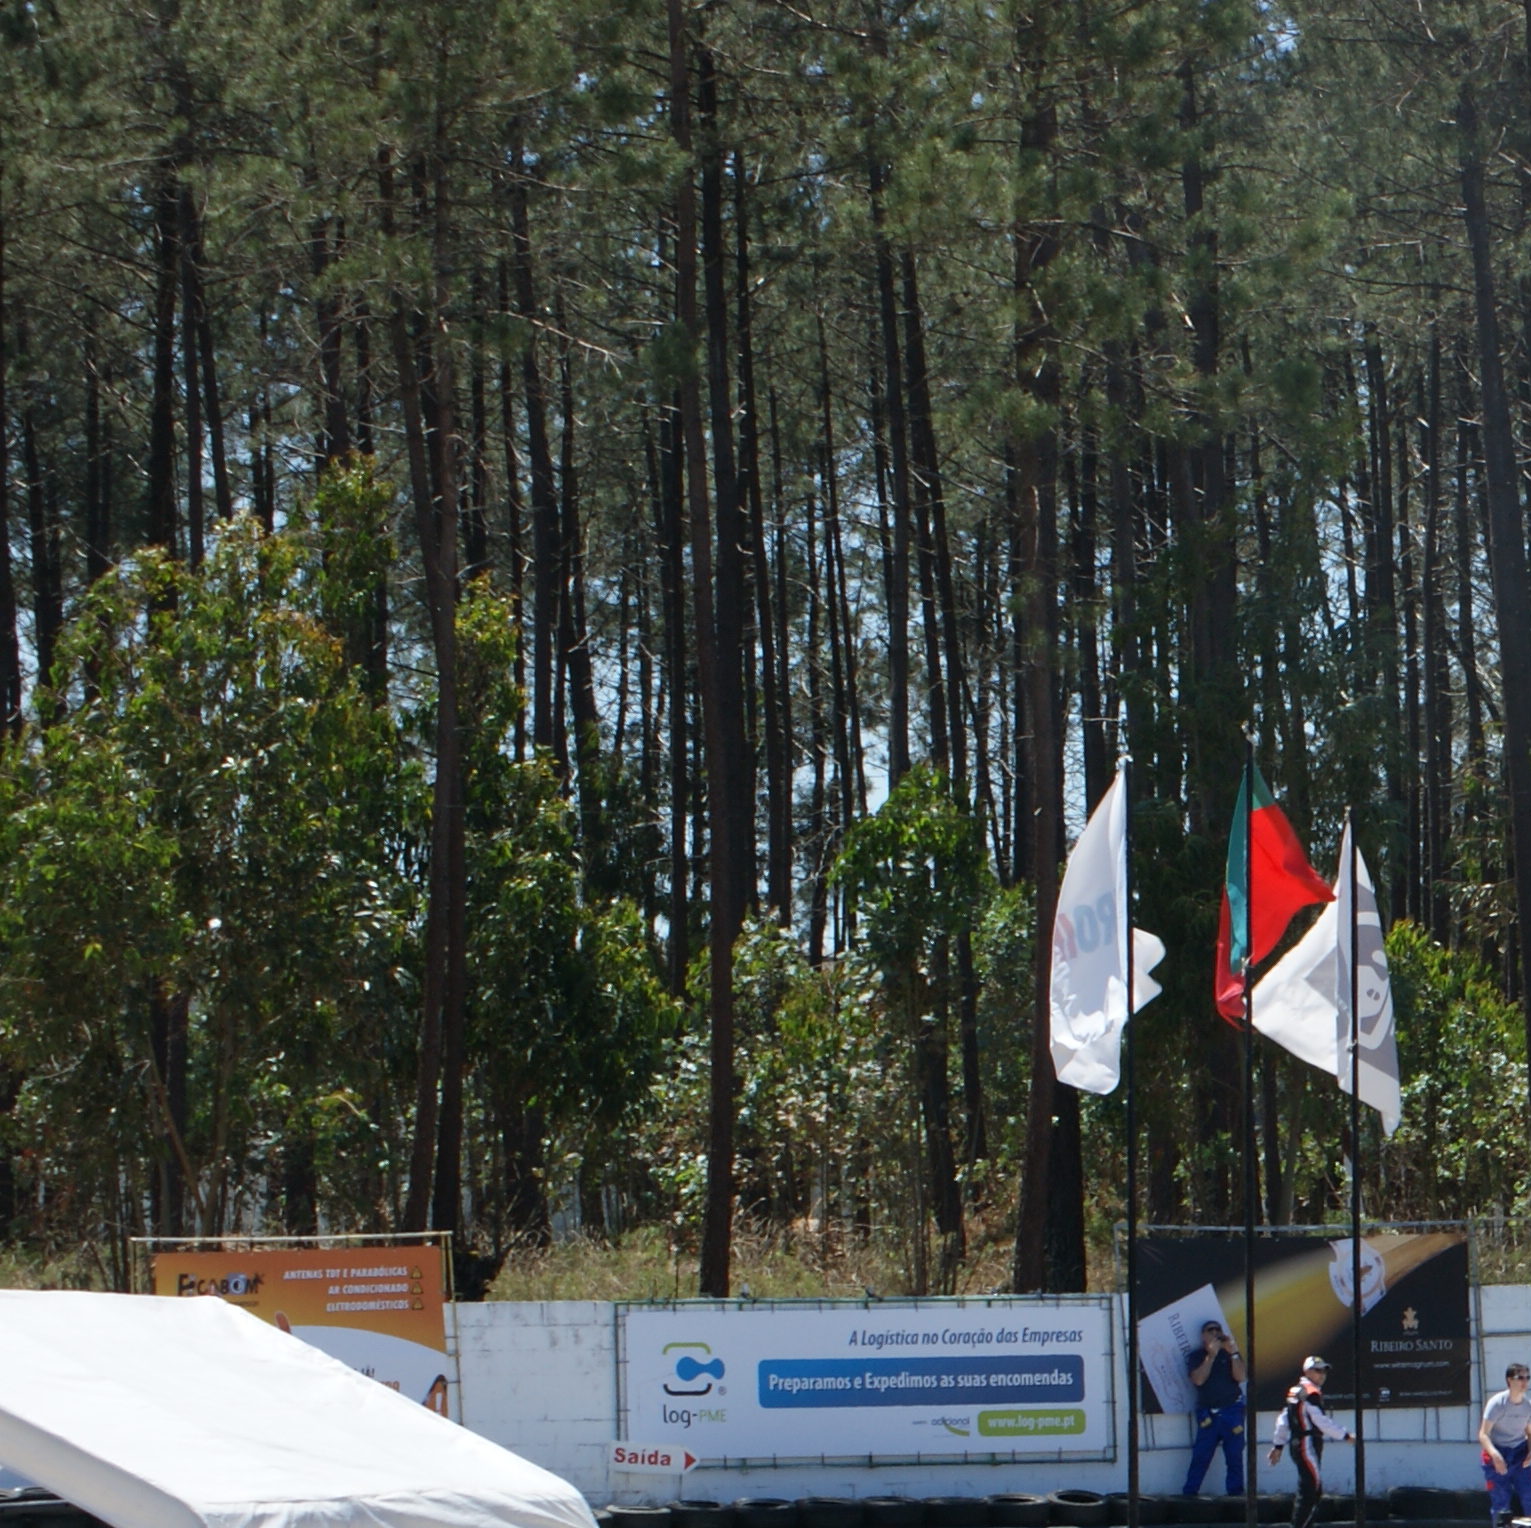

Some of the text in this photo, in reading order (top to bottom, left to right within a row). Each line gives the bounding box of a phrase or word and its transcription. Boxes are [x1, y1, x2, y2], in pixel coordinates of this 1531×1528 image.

[283, 1269, 323, 1281] ANTENAS
[325, 1268, 342, 1279] TDT
[328, 1283, 408, 1295] AR CONDICIONADO
[849, 1327, 1084, 1349] A Logística no Coração das Empresas
[1415, 1338, 1453, 1351] SANTO
[768, 1369, 1073, 1394] Preparamos e Expedimos as suas encomendas
[663, 1405, 727, 1429] log-PME
[986, 1414, 1075, 1430] www.log-pme.pt
[614, 1447, 671, 1466] Saída
